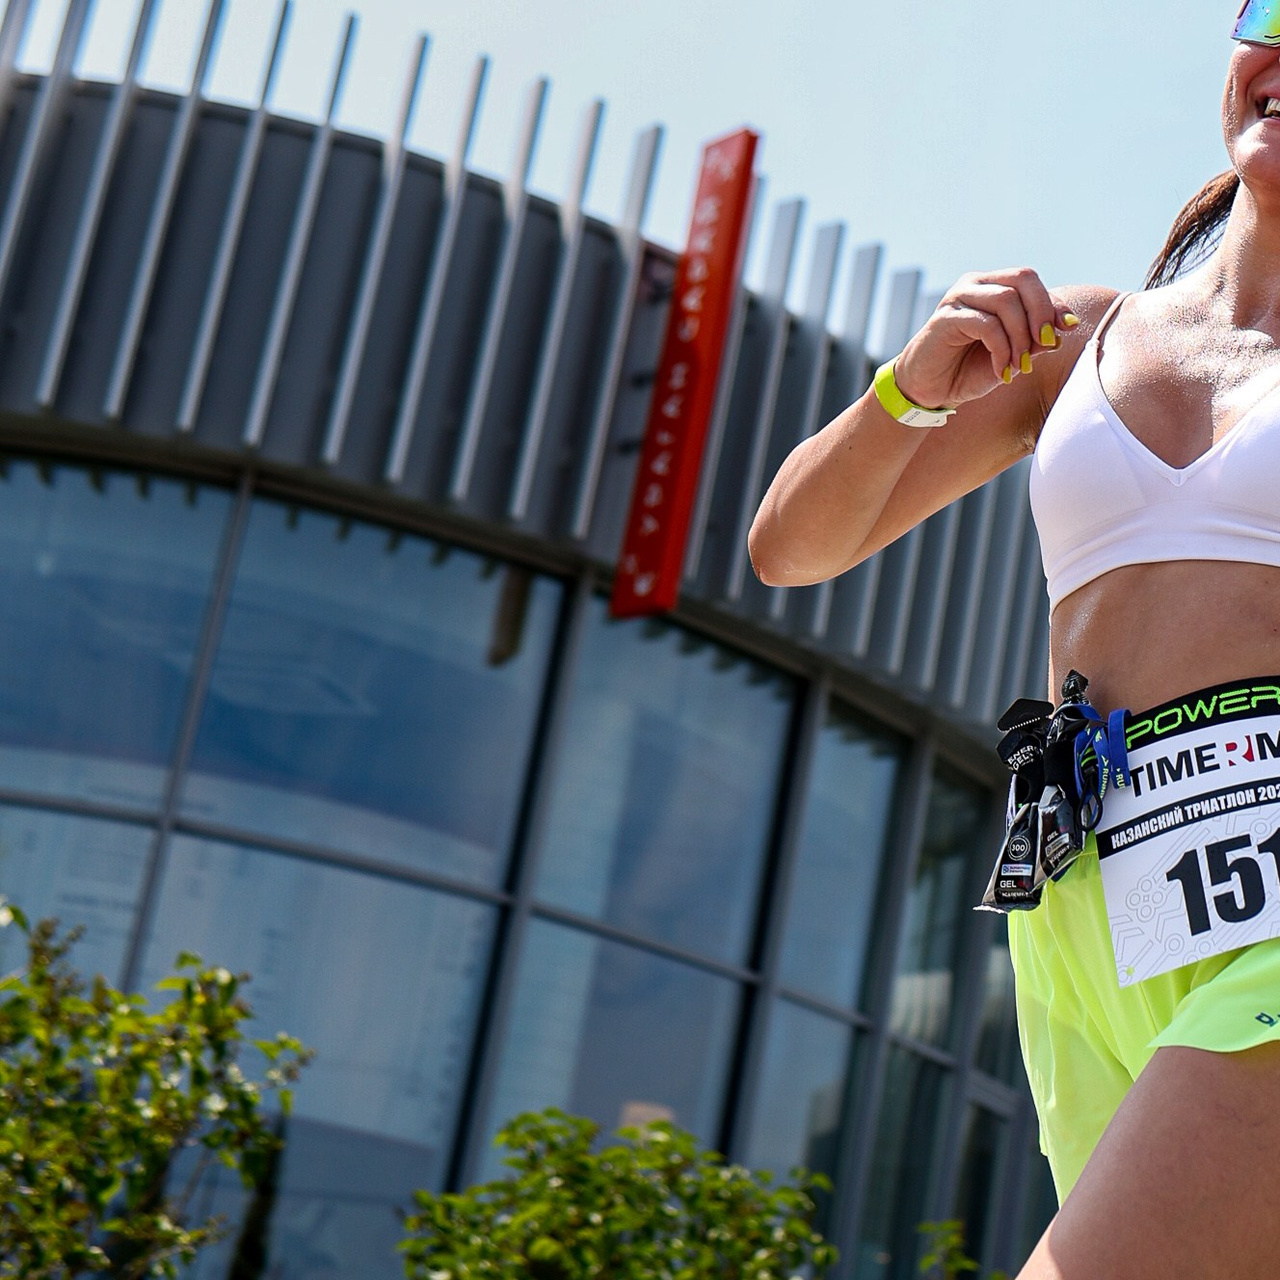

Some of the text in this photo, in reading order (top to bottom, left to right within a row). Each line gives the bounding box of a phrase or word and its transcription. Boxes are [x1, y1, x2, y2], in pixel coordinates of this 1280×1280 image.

[1111, 807, 1185, 850] КАЗАНСКИЙ
[1185, 786, 1256, 820] ТРИАТЛОН
[1011, 844, 1025, 852] 300
[1000, 880, 1017, 888] GEL
